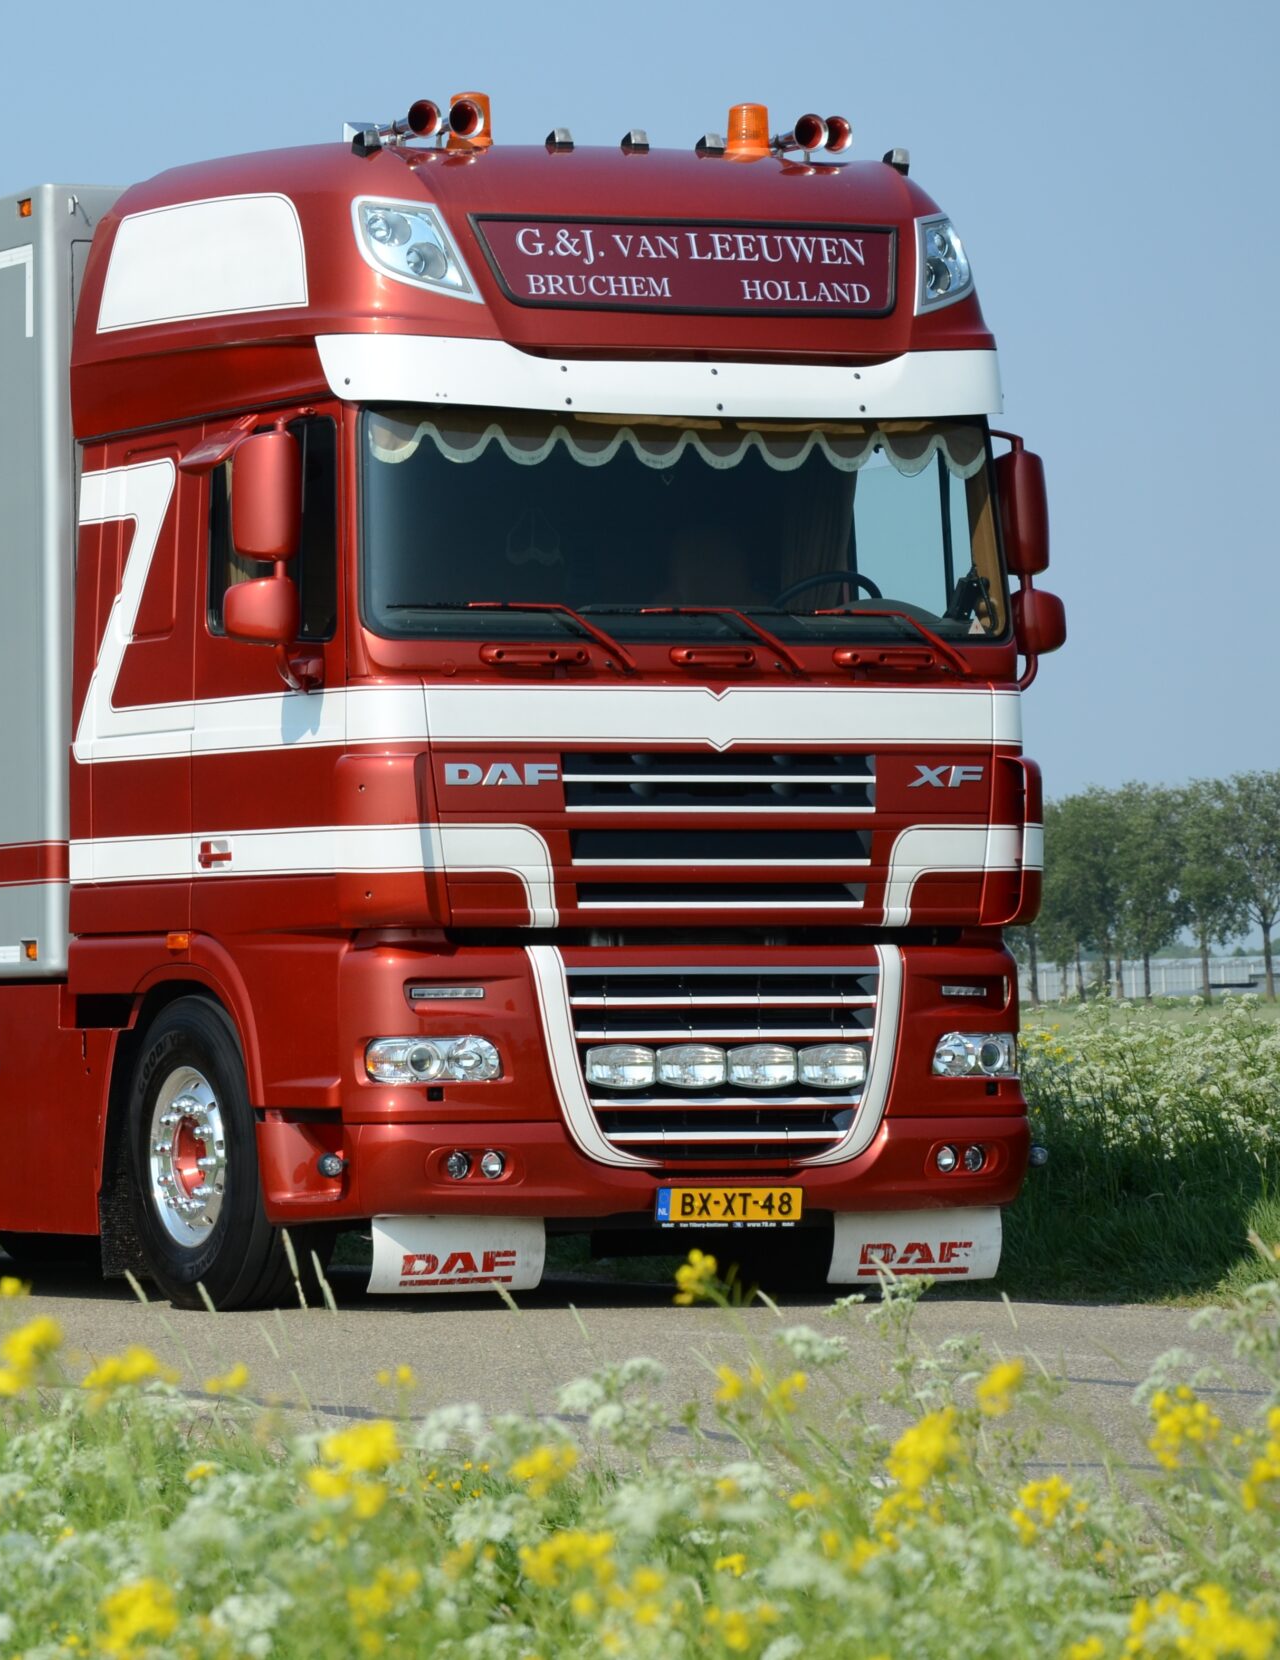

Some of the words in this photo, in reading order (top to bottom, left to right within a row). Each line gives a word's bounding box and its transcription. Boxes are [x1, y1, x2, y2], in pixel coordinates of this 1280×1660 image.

[515, 228, 605, 265] G.&J.
[611, 234, 680, 259] VAN
[684, 232, 865, 266] LEEUWEN
[525, 274, 672, 298] BRUCHEM
[740, 279, 871, 304] HOLLAND
[444, 763, 558, 786] DAF
[907, 765, 984, 787] XF
[658, 1208, 668, 1216] NL
[681, 1192, 792, 1217] BX-XT-48
[401, 1250, 517, 1276] DAF
[858, 1241, 973, 1265] DAF
